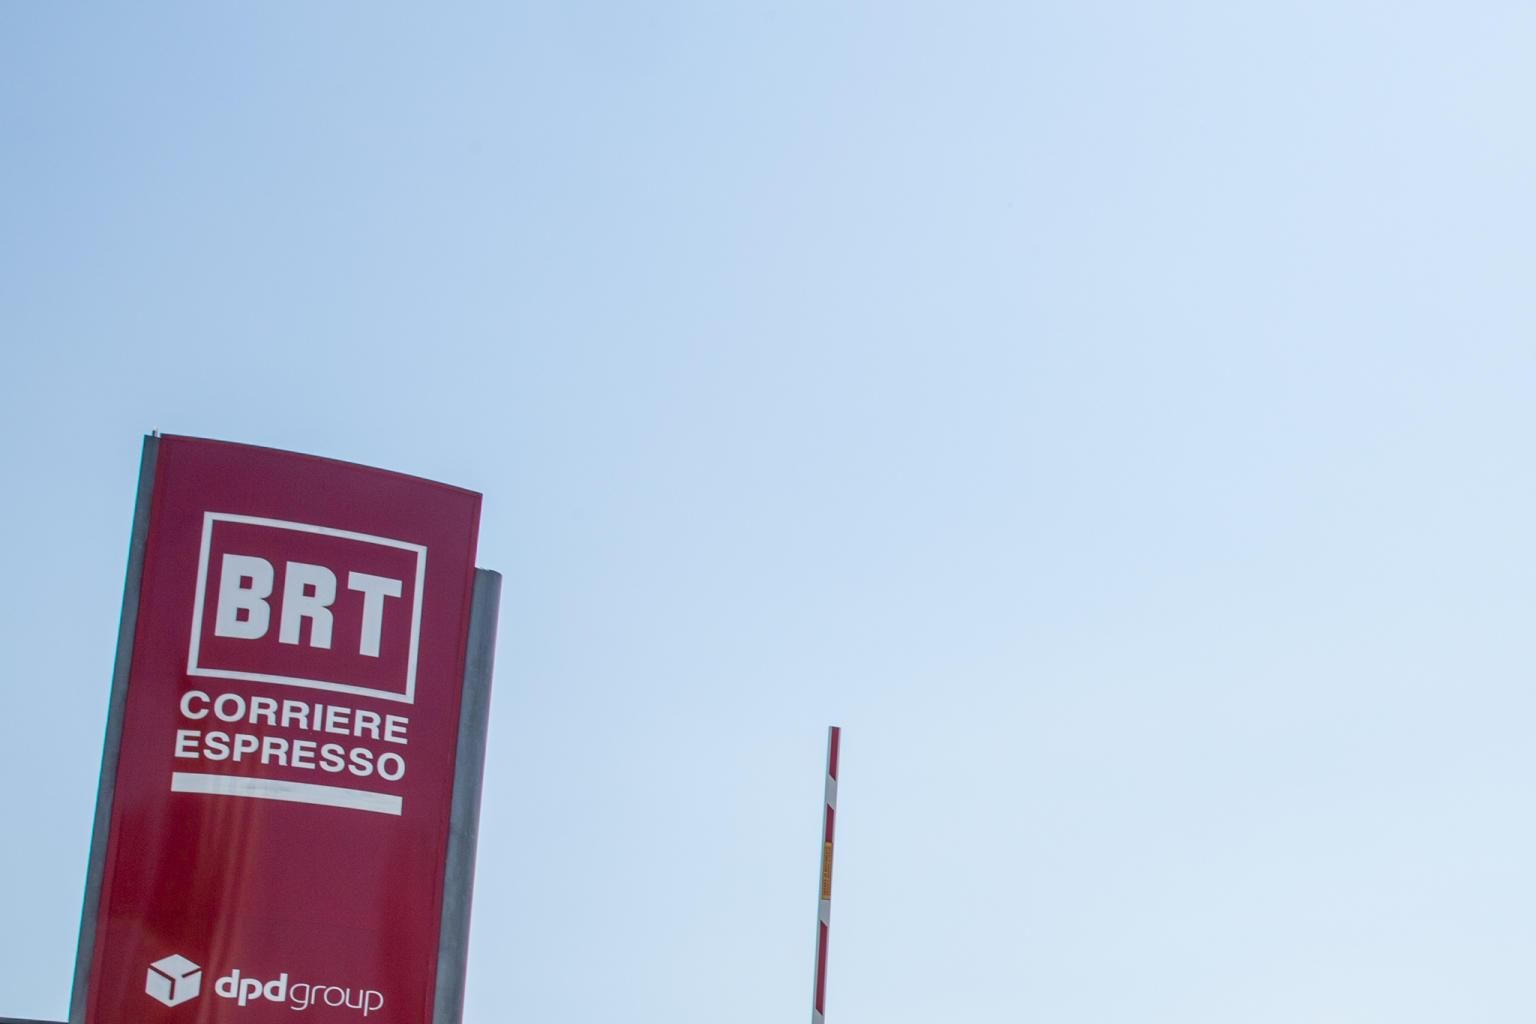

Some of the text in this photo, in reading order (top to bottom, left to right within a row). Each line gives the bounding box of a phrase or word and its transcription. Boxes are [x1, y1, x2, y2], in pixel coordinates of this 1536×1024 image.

[214, 553, 403, 658] BRT
[180, 690, 409, 745] CORRIERE
[174, 729, 406, 781] ESPRESSO
[215, 968, 384, 1016] dpdgroup
